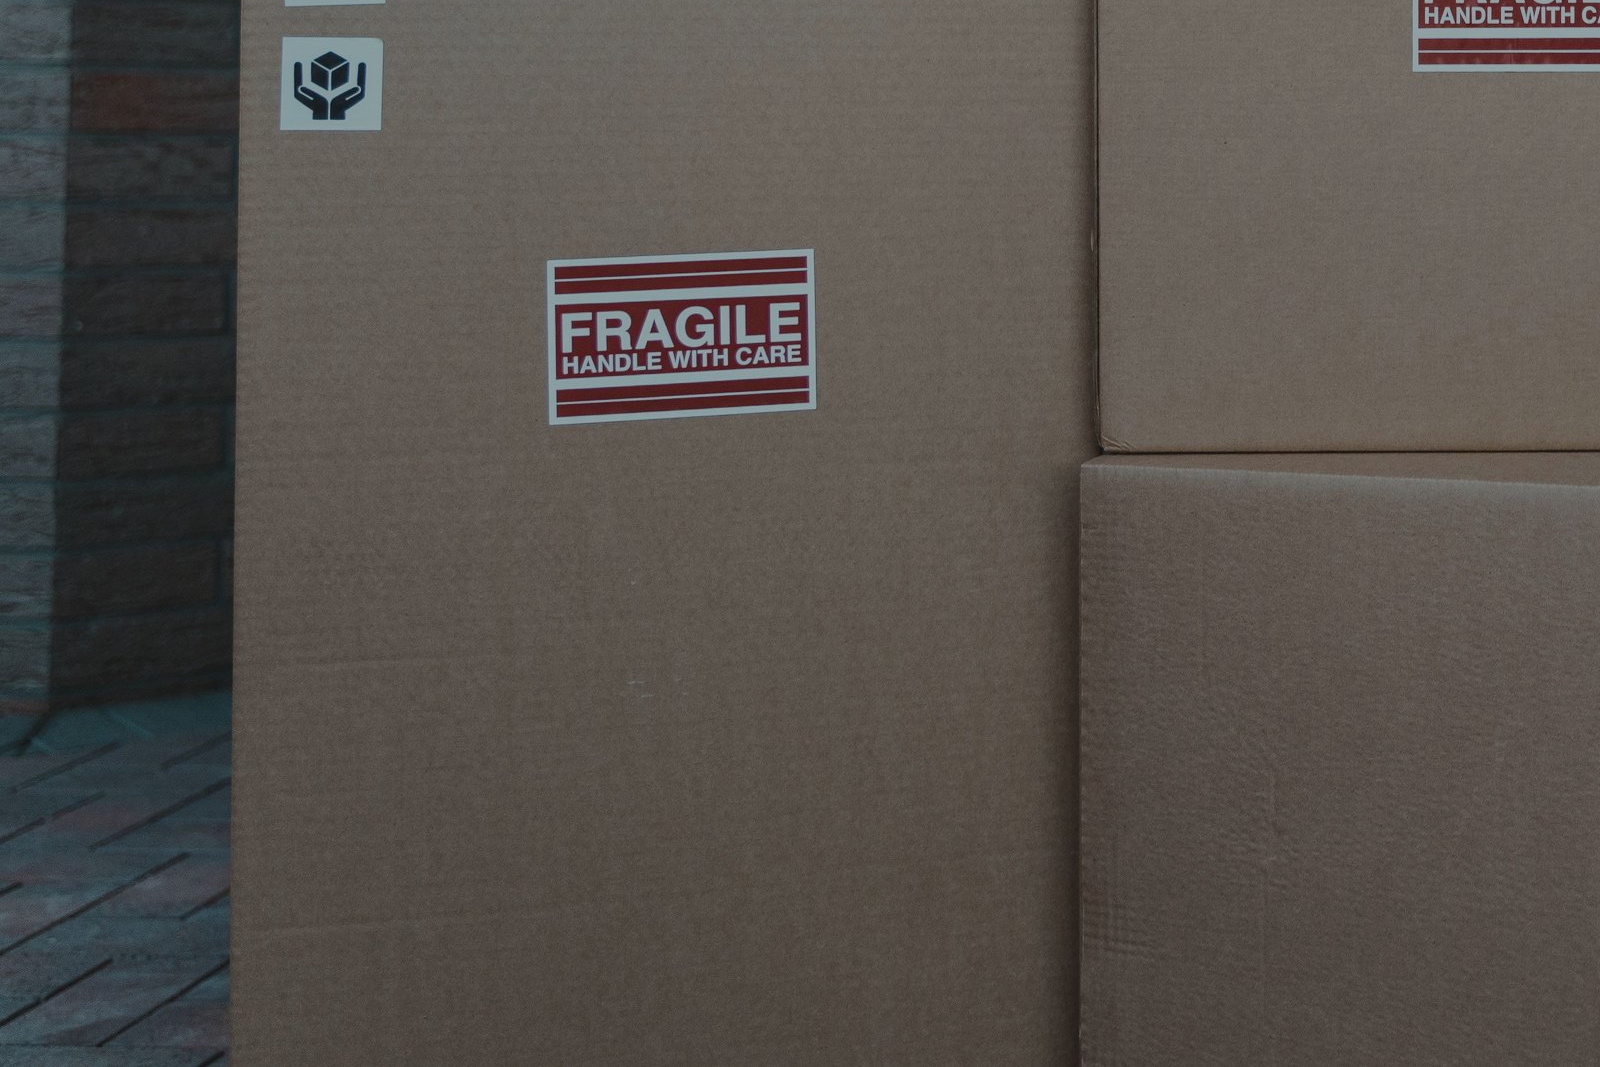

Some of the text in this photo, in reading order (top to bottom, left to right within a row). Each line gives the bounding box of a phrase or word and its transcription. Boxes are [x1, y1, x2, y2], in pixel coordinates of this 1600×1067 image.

[1424, 6, 1514, 24] HANDLE
[1520, 6, 1575, 24] WITH
[561, 302, 802, 354] FRAGILE
[562, 344, 802, 375] HANDLE WITH CARE
